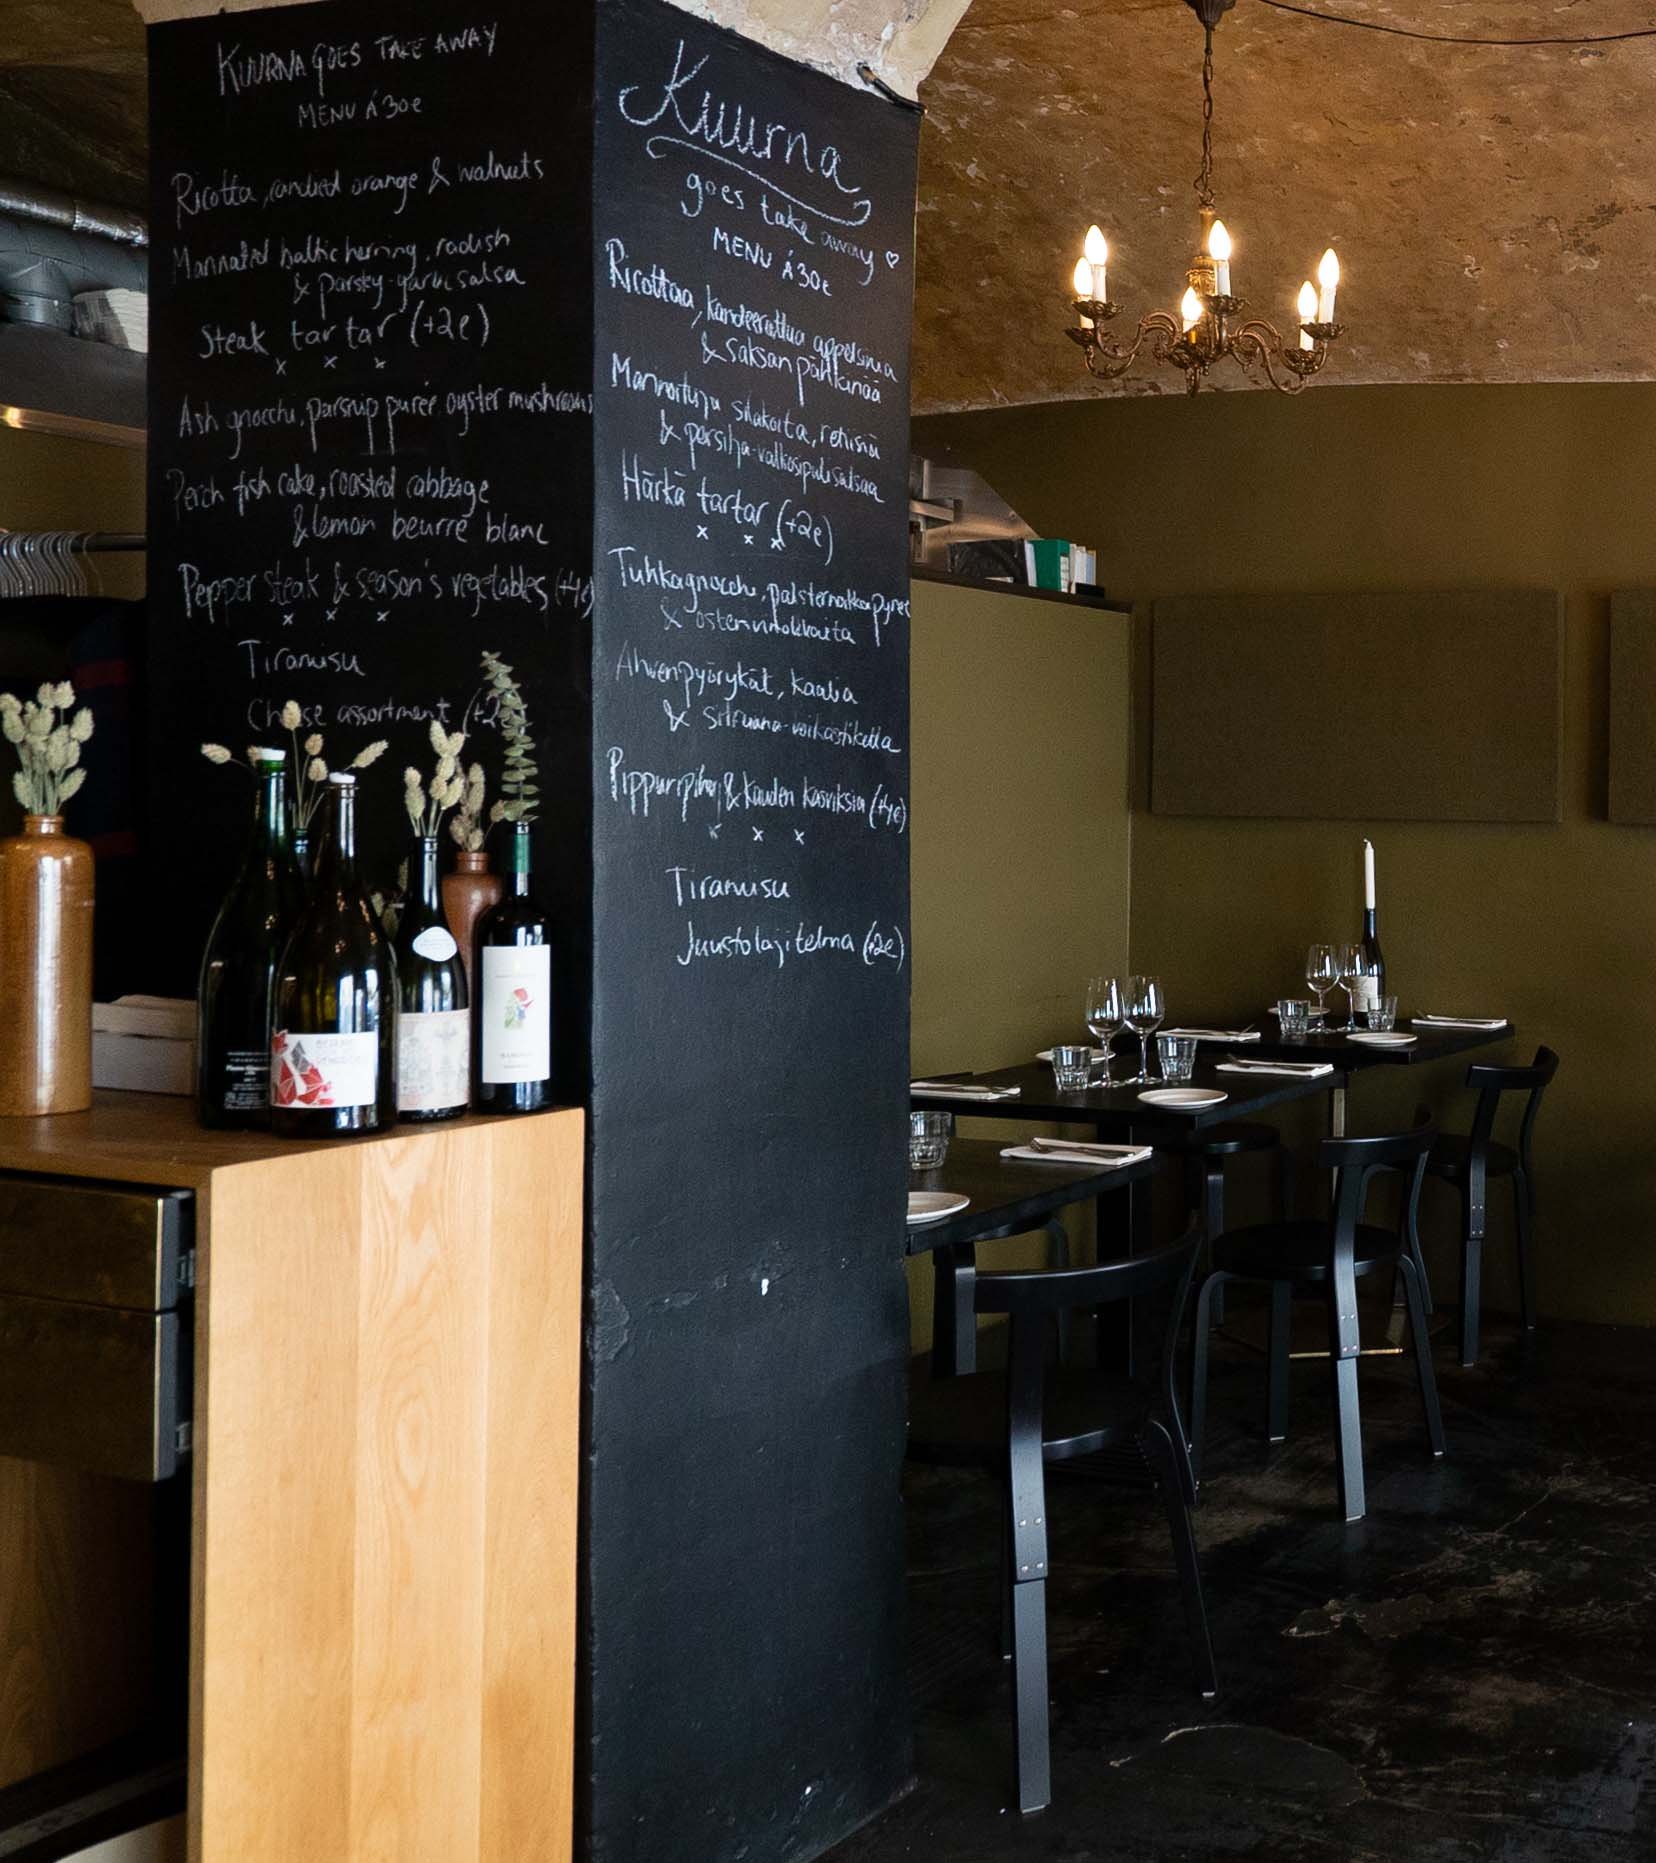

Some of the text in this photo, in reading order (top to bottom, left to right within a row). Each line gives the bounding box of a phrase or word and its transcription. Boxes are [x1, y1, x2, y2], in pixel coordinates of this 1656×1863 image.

[217, 41, 306, 96] KUURNA
[434, 22, 498, 56] AWAY
[299, 101, 356, 128] MENU
[618, 39, 861, 194] Kuurna
[352, 171, 418, 214] orange
[428, 156, 450, 194] &
[457, 150, 545, 184] walnuts
[681, 172, 745, 218] goes
[761, 194, 815, 245] take
[436, 227, 511, 257] radish
[713, 226, 772, 269] MENU
[293, 273, 311, 304] &
[457, 263, 526, 289] salsa
[200, 321, 270, 358] Steak
[701, 330, 727, 364] &
[180, 396, 219, 438] Ash
[307, 396, 379, 454] parsnip
[446, 383, 500, 437] oyster
[660, 408, 681, 445] &
[166, 468, 224, 520] Perch
[233, 466, 270, 517] fish
[329, 466, 396, 499] roasted
[406, 466, 490, 518] cabbage
[313, 504, 377, 539] lemon
[486, 512, 550, 546] blanc
[178, 563, 256, 623] Pepper
[334, 560, 351, 604] &
[452, 564, 549, 617] vegetables
[238, 639, 367, 678] Tiramisu
[337, 698, 450, 728] assortment
[663, 699, 690, 733] &
[723, 771, 739, 812] &
[665, 865, 792, 907] Tiramisu
